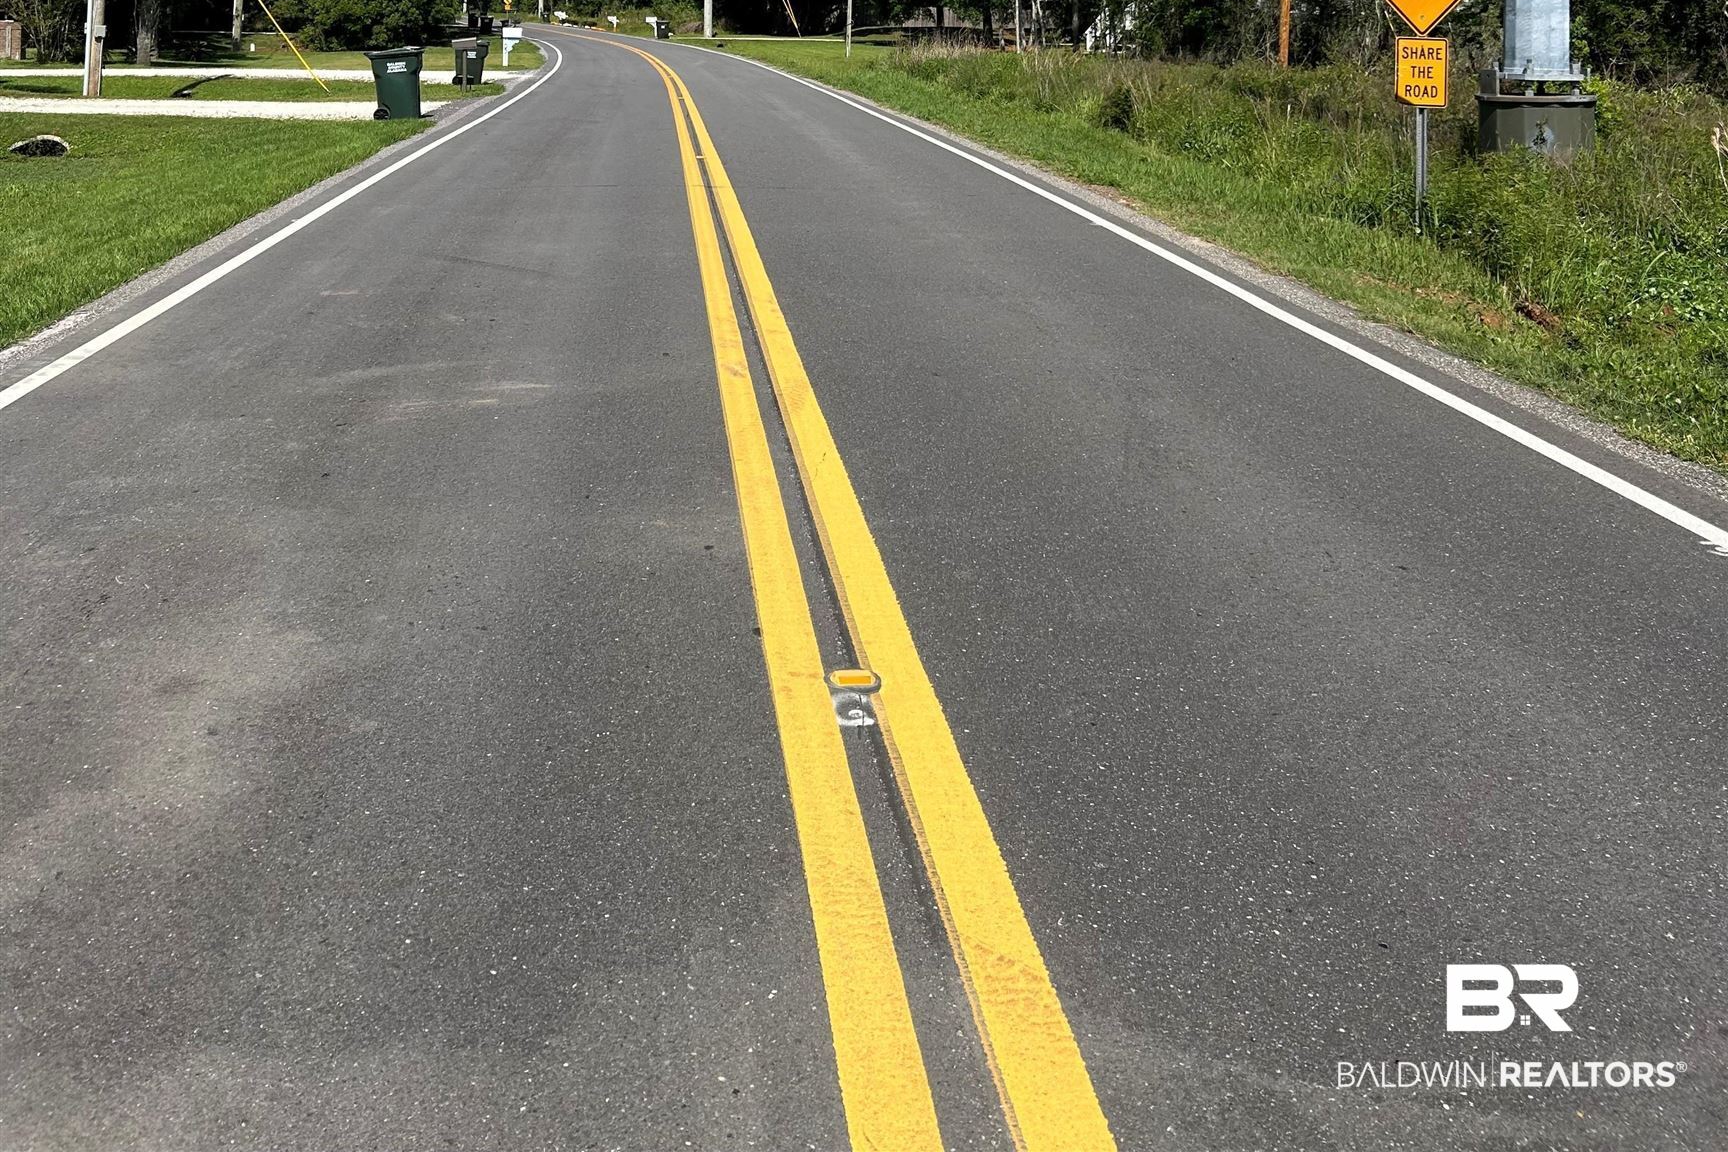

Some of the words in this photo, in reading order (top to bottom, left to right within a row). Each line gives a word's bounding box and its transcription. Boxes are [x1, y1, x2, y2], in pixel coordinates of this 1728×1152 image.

[1402, 47, 1443, 61] SHARE
[1411, 66, 1434, 79] THE
[1404, 85, 1438, 98] ROAD
